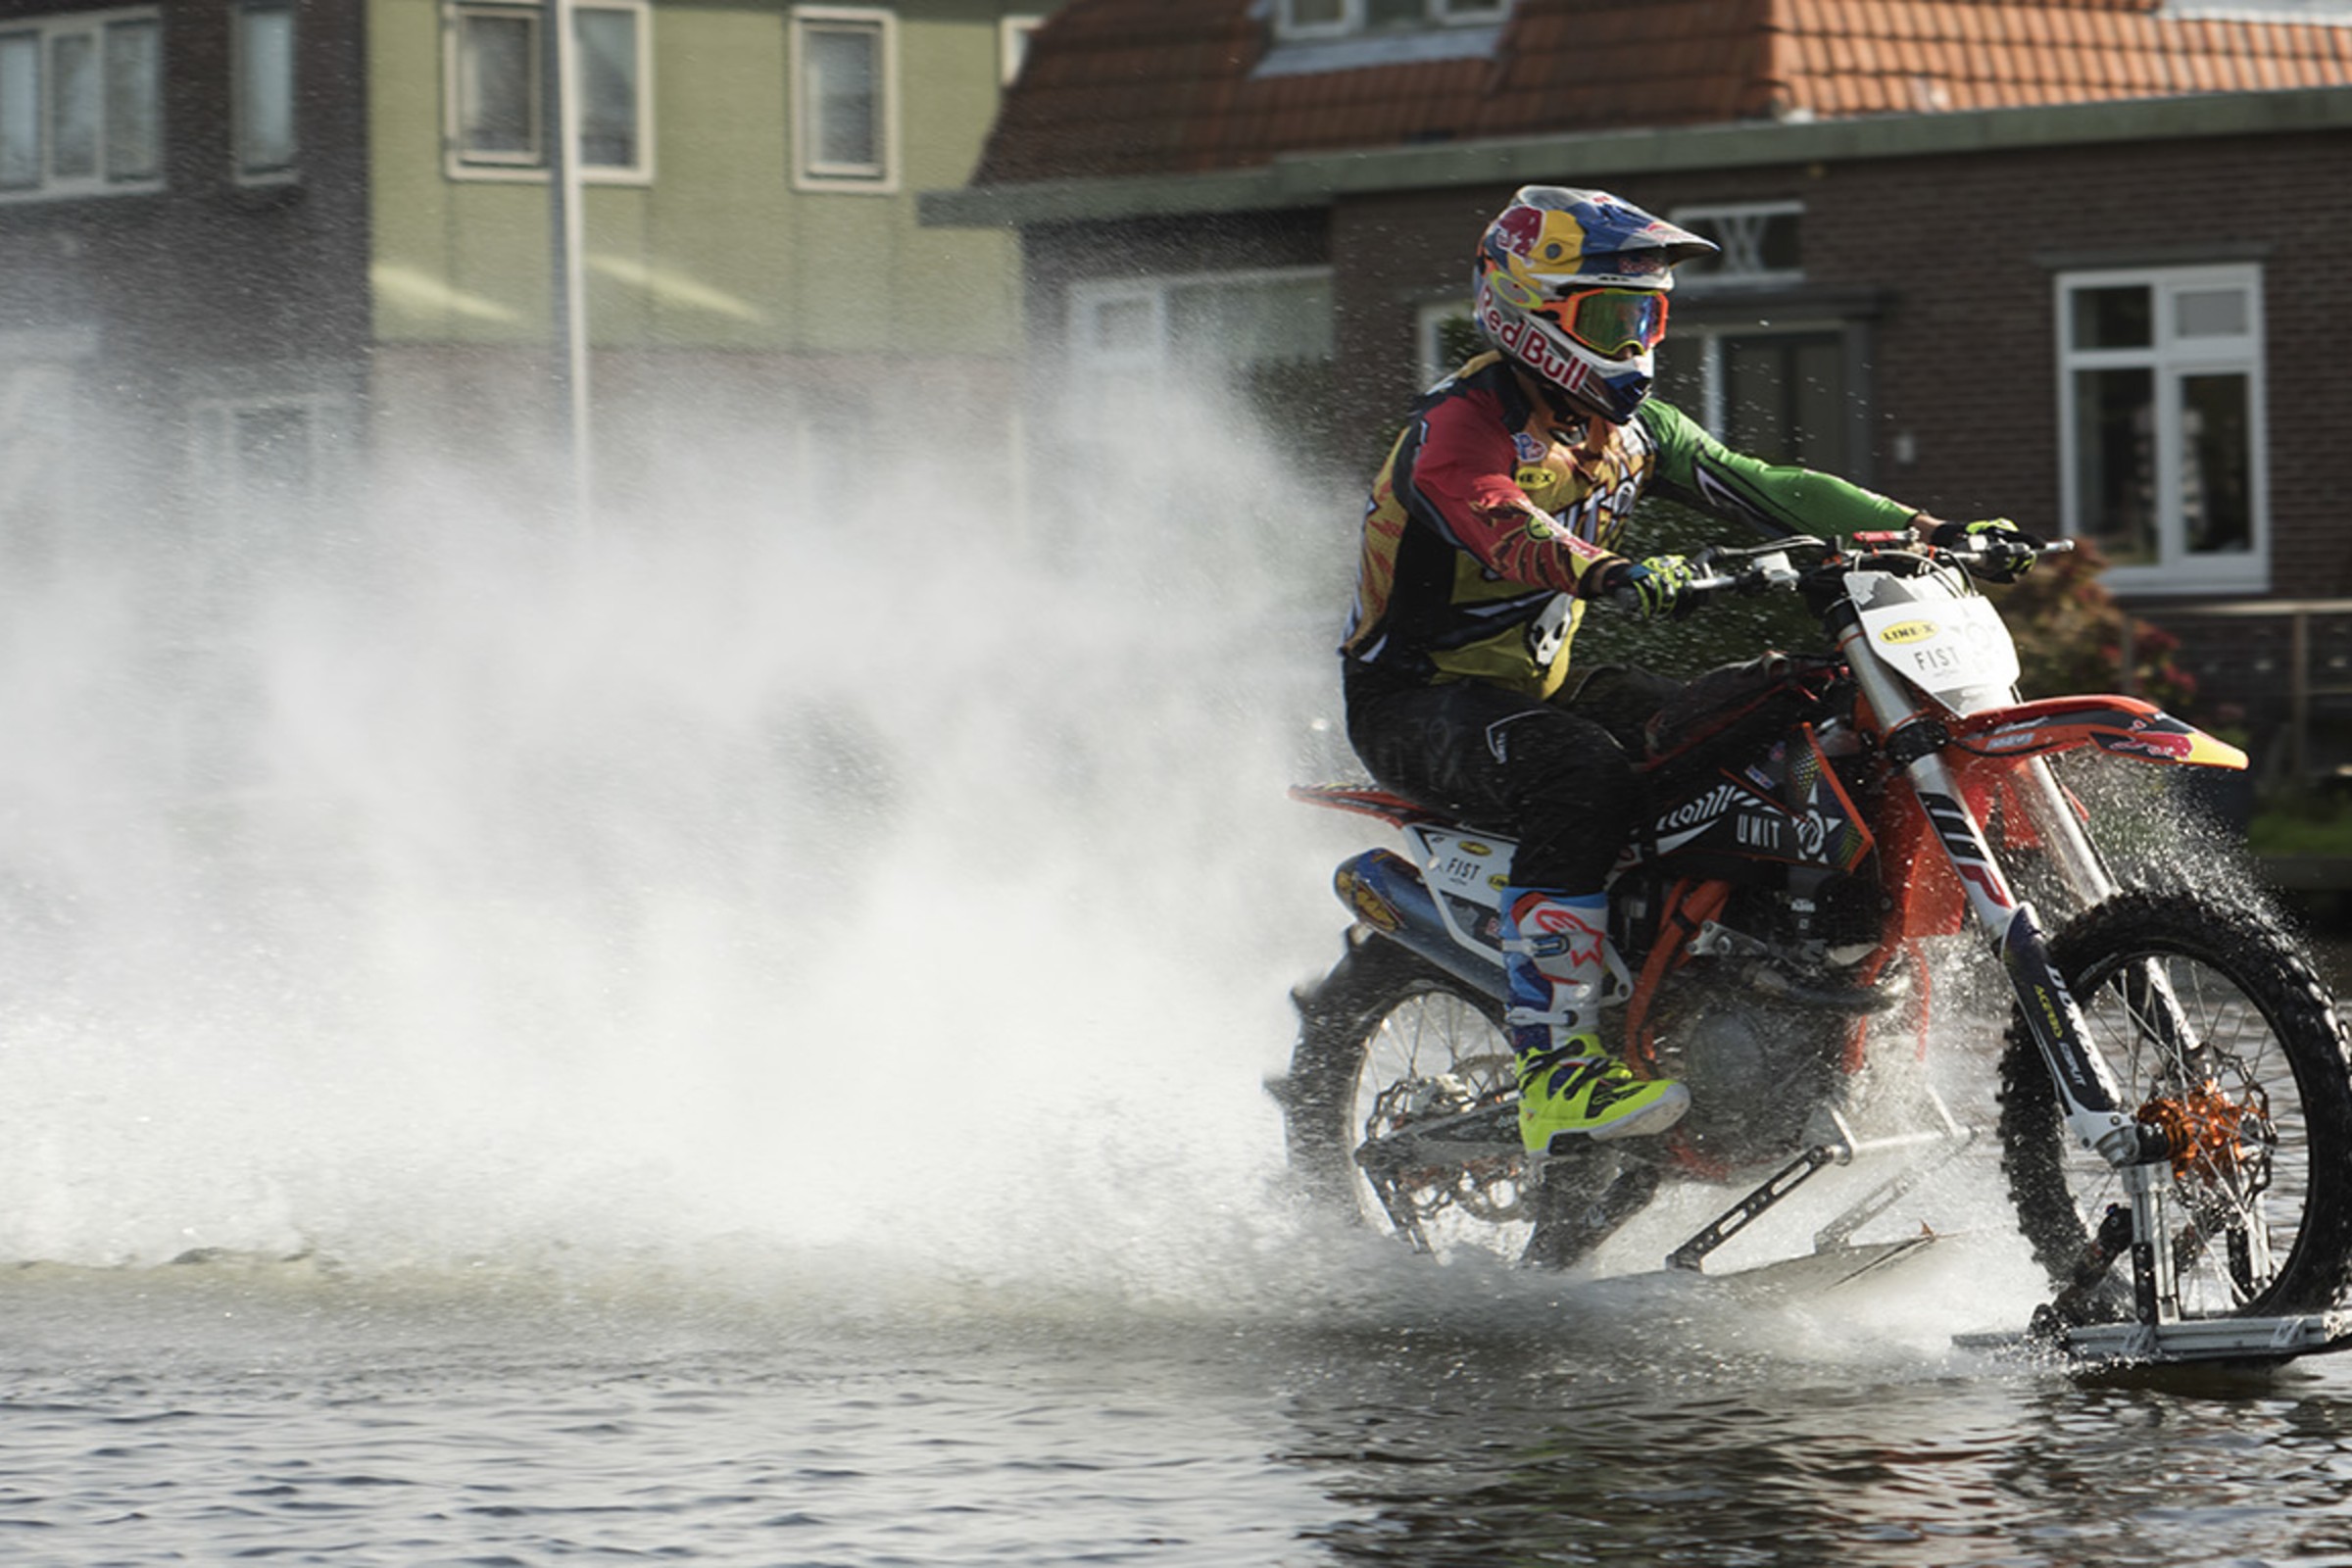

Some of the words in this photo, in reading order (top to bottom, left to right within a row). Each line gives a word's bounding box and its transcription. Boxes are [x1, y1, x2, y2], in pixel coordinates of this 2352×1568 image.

[1479, 284, 1526, 351] Red
[1520, 328, 1590, 392] Bull
[1883, 624, 1935, 643] LINE-X
[1914, 646, 1960, 670] FIST
[1737, 814, 1781, 850] UNIT
[1446, 858, 1482, 881] FIST
